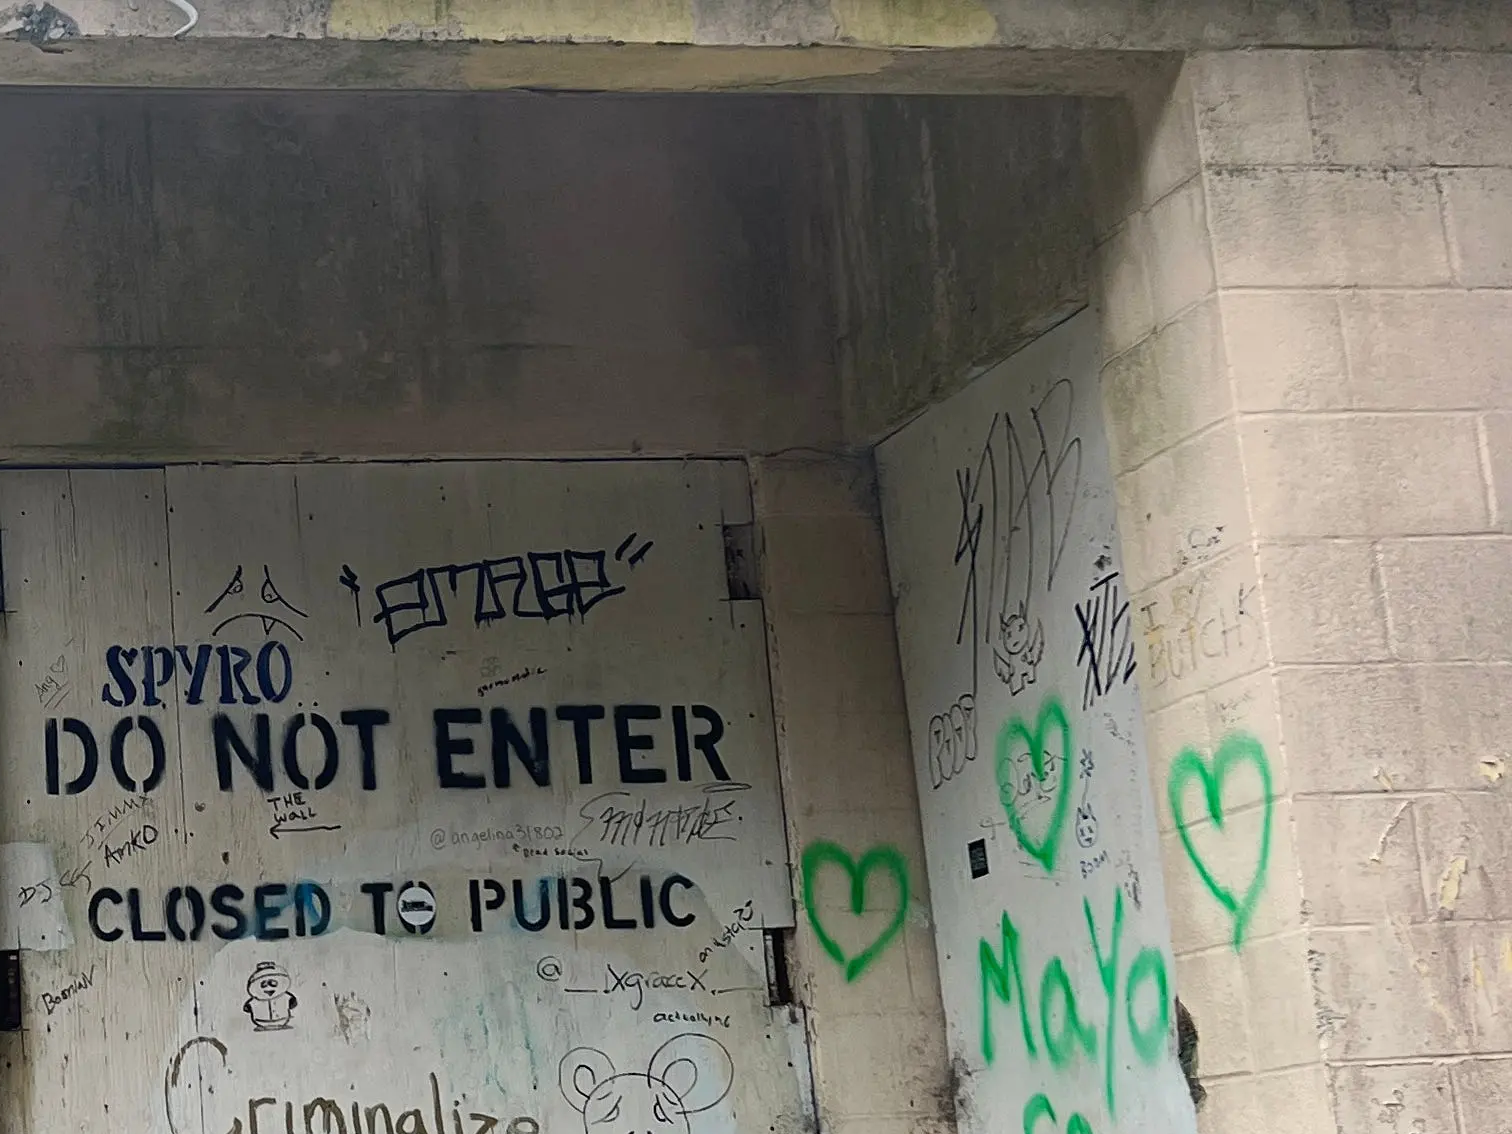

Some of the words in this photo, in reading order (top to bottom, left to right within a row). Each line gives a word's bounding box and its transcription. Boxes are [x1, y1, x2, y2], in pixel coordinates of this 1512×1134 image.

[101, 640, 292, 708] SPYRO
[44, 714, 167, 796] DO
[212, 707, 391, 793] NOT
[433, 703, 731, 790] ENTER
[267, 792, 306, 811] THE
[88, 881, 331, 942] CLOSED
[361, 880, 437, 935] TO
[470, 874, 696, 932] PUBLIC
